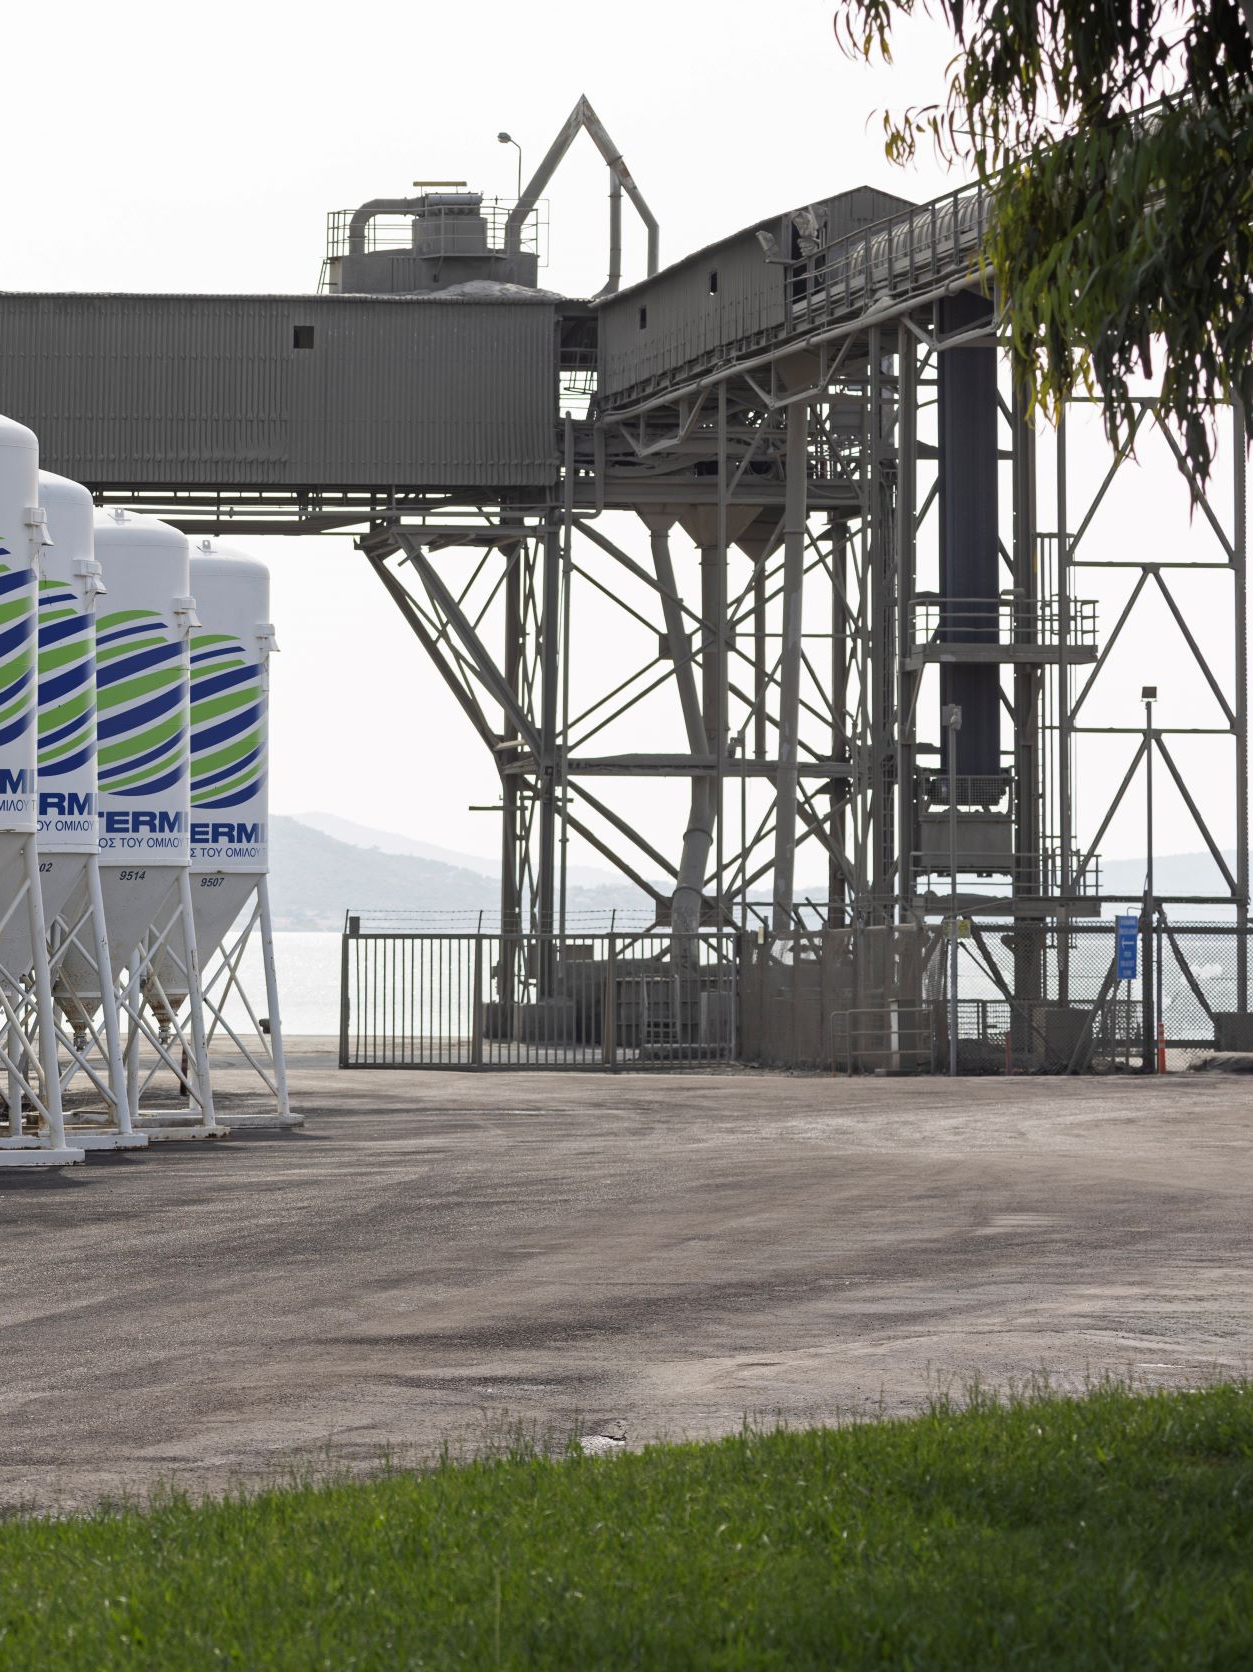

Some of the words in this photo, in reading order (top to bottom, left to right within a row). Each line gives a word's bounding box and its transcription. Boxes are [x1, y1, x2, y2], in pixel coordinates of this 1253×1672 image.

[119, 837, 144, 848] ΤΟΥ
[200, 847, 223, 858] ΤΟΥ
[119, 870, 146, 881] 9514
[200, 877, 226, 888] 9507
